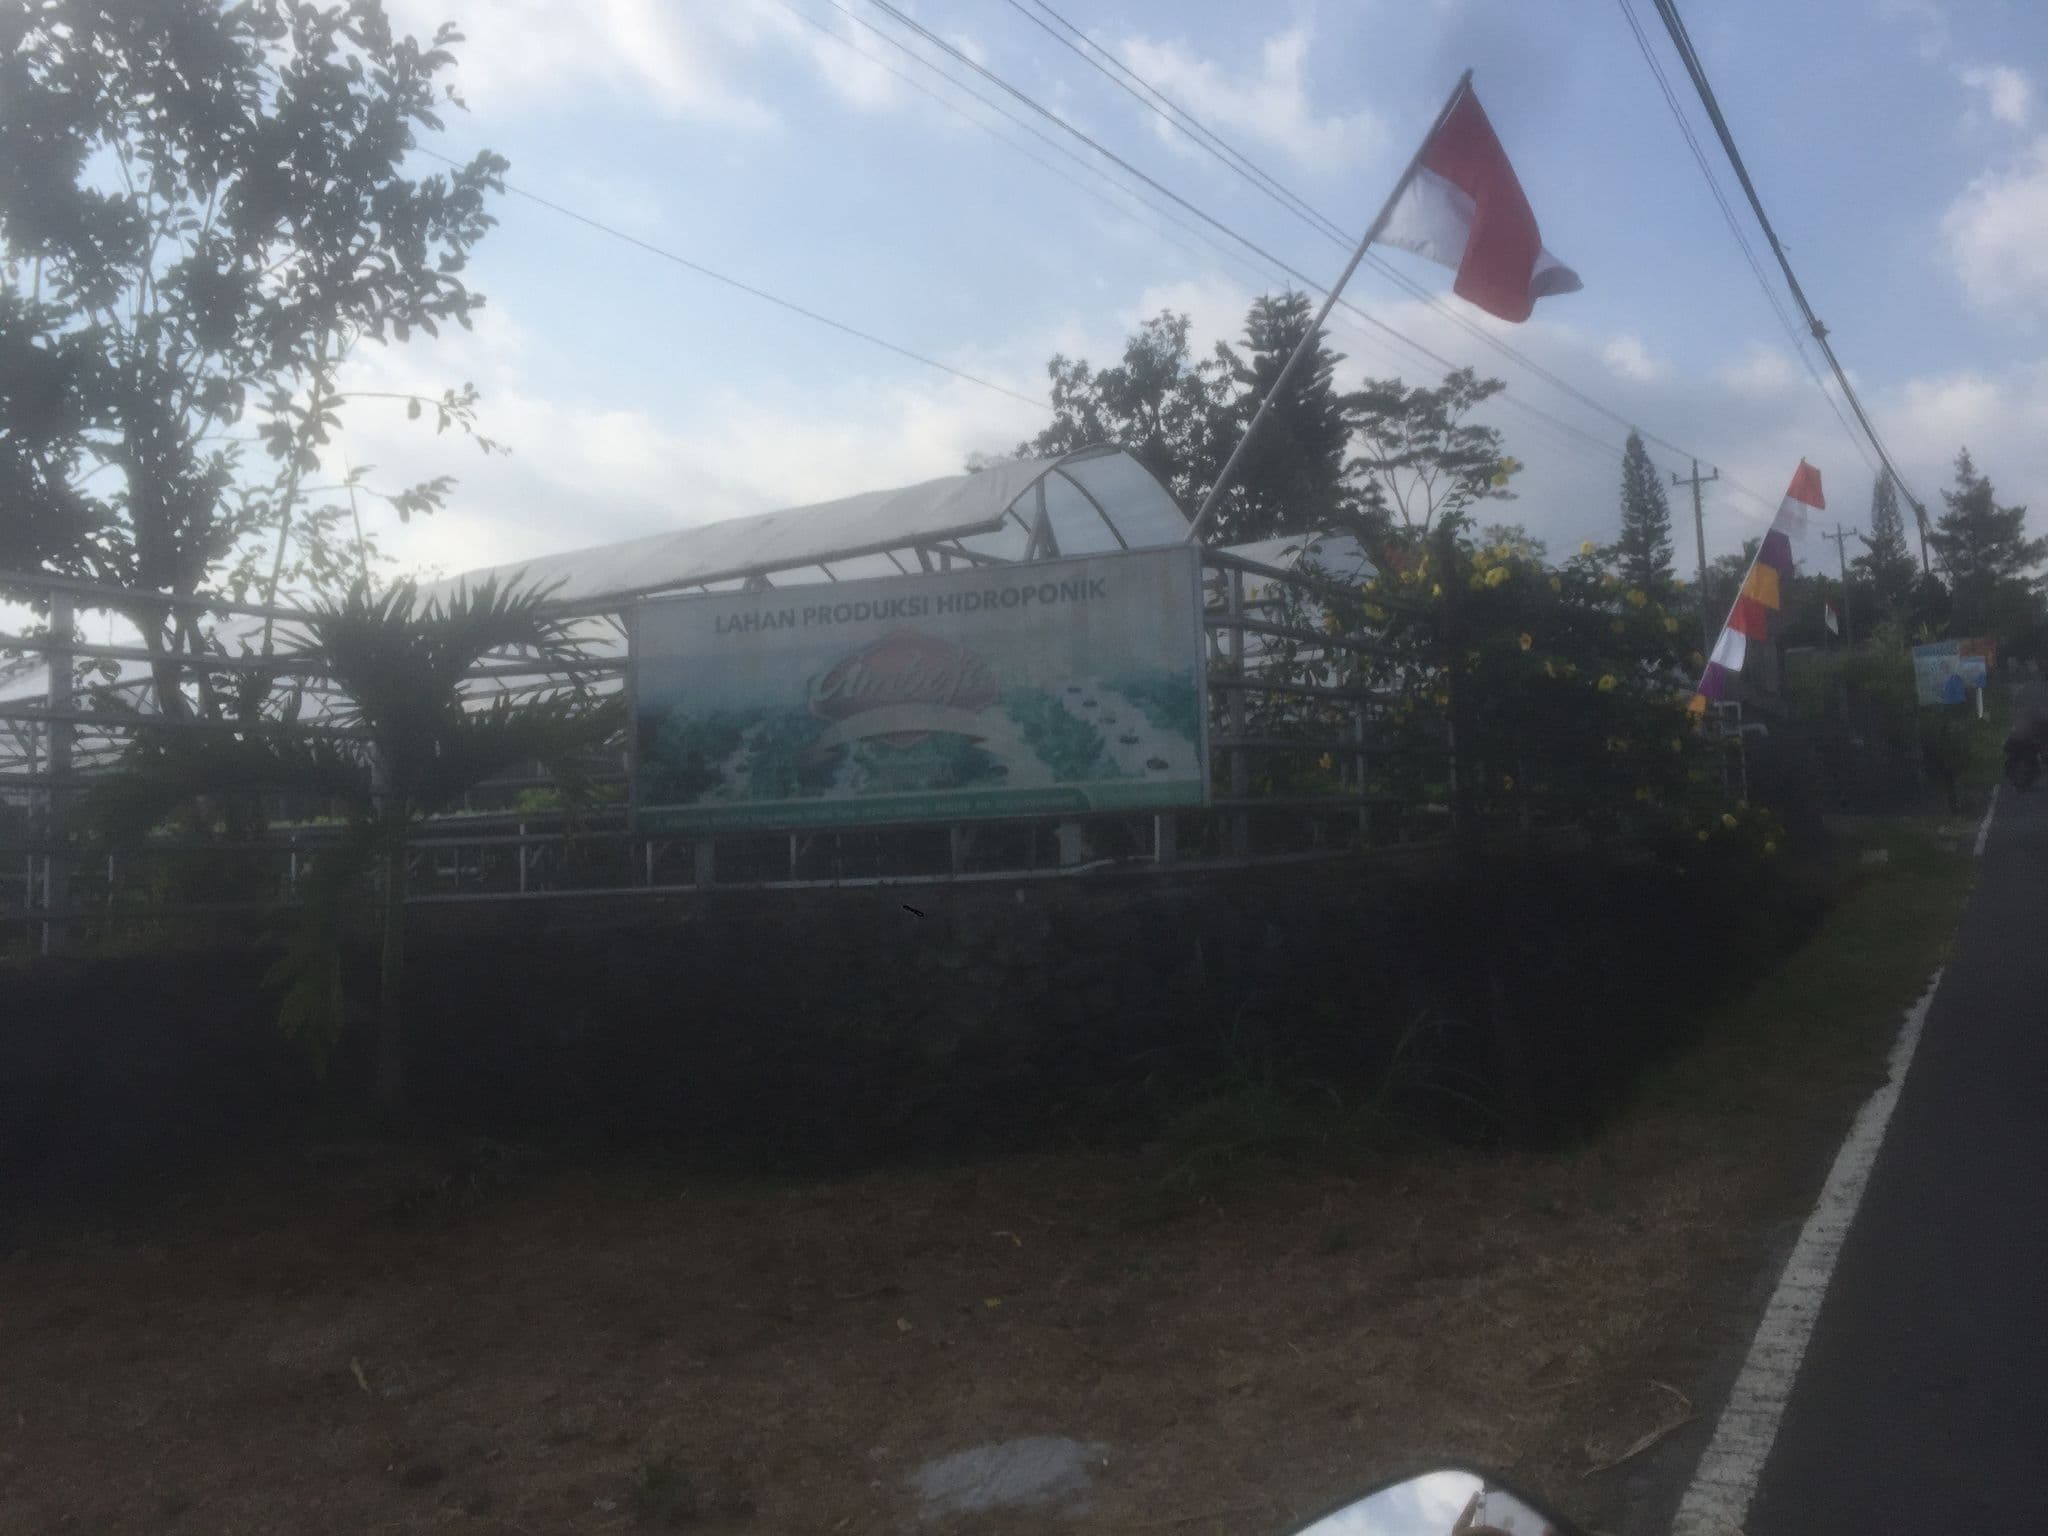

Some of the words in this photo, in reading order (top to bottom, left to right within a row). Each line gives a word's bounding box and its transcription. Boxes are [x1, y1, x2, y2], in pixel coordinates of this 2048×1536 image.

[714, 607, 796, 634] LAHAN
[803, 596, 928, 626] PRODUKSI
[937, 578, 1106, 615] HIDROPONIK
